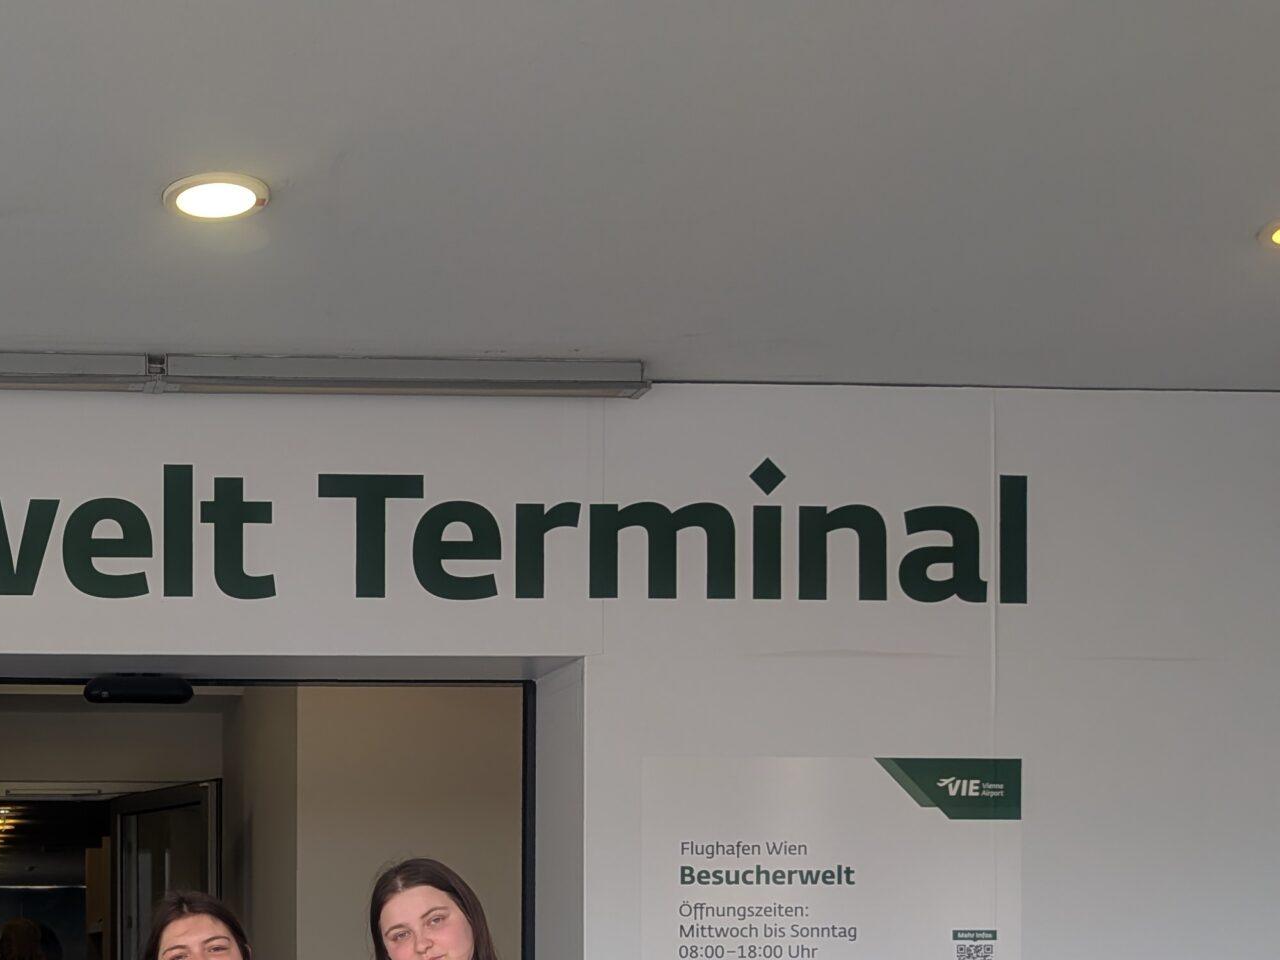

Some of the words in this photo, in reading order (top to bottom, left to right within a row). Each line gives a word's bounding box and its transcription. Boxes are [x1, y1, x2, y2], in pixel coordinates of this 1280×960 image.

[318, 457, 1028, 604] Terminal
[947, 779, 981, 796] VIE
[980, 790, 1004, 798] Airport
[681, 841, 761, 859] Flughafen
[765, 841, 808, 856] Wien
[680, 865, 856, 886] Besucherwelt
[679, 901, 809, 920] Öffnungszeiten:
[679, 923, 759, 938] Mittwoch
[763, 924, 786, 938] bis
[790, 924, 857, 942] Sonntag
[788, 944, 819, 959] Uhr
